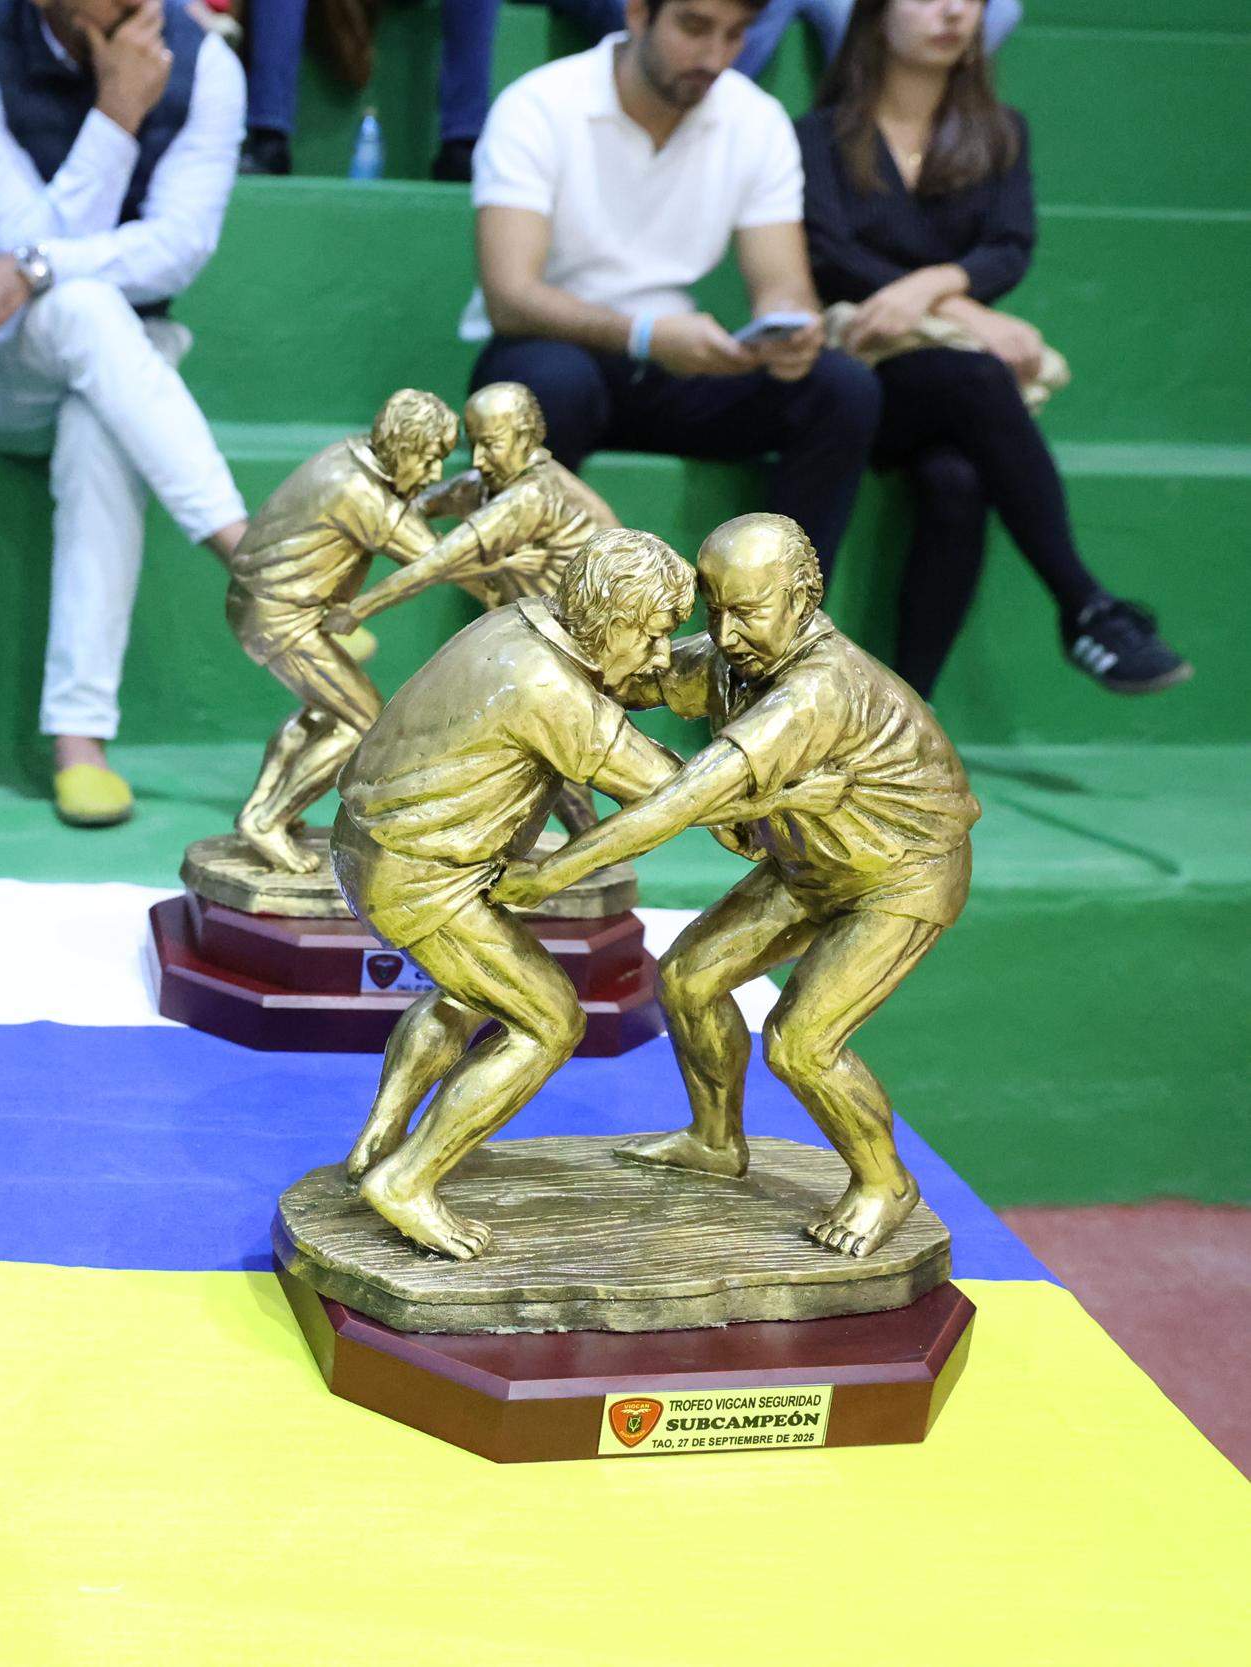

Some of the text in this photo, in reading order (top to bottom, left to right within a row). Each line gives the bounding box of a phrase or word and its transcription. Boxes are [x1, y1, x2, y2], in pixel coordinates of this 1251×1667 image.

[669, 1394, 822, 1412] TROFEO VIGCAN SEGURIDAD
[665, 1410, 821, 1432] SUBCAMPEÓN
[652, 1438, 675, 1449] TAO,
[677, 1438, 689, 1448] 27
[691, 1437, 706, 1447] DE
[708, 1435, 774, 1447] SEPTIEMBRE
[775, 1433, 790, 1444] DE
